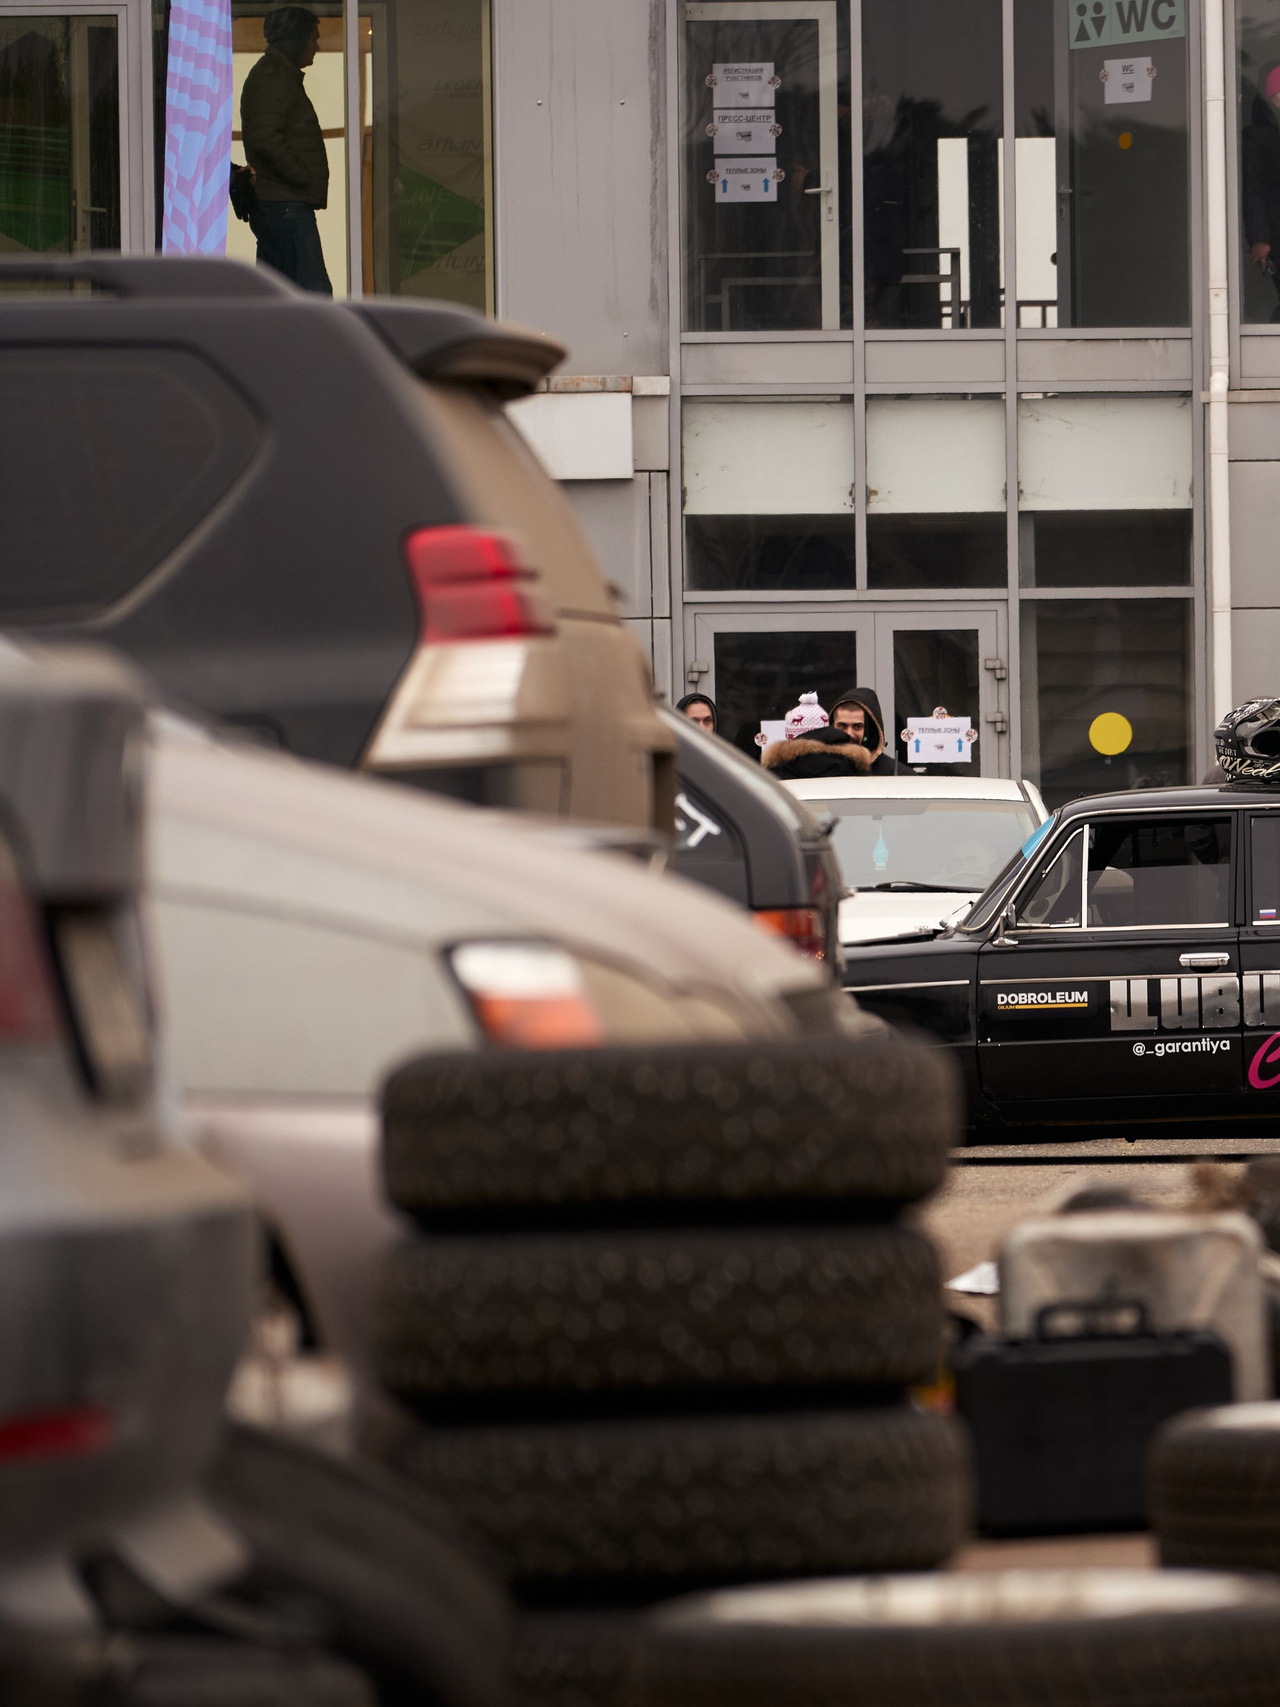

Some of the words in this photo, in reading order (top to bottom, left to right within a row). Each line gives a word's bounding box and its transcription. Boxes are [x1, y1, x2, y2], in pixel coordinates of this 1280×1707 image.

[1115, 0, 1176, 34] WC
[723, 67, 764, 75] РЕГИСТРАЦИЯ
[1121, 64, 1135, 74] WC
[717, 115, 772, 123] ПРЕСС-ЦЕНТР
[997, 990, 1088, 1005] DOBROLEUM
[1132, 1037, 1231, 1057] @_garantiya
